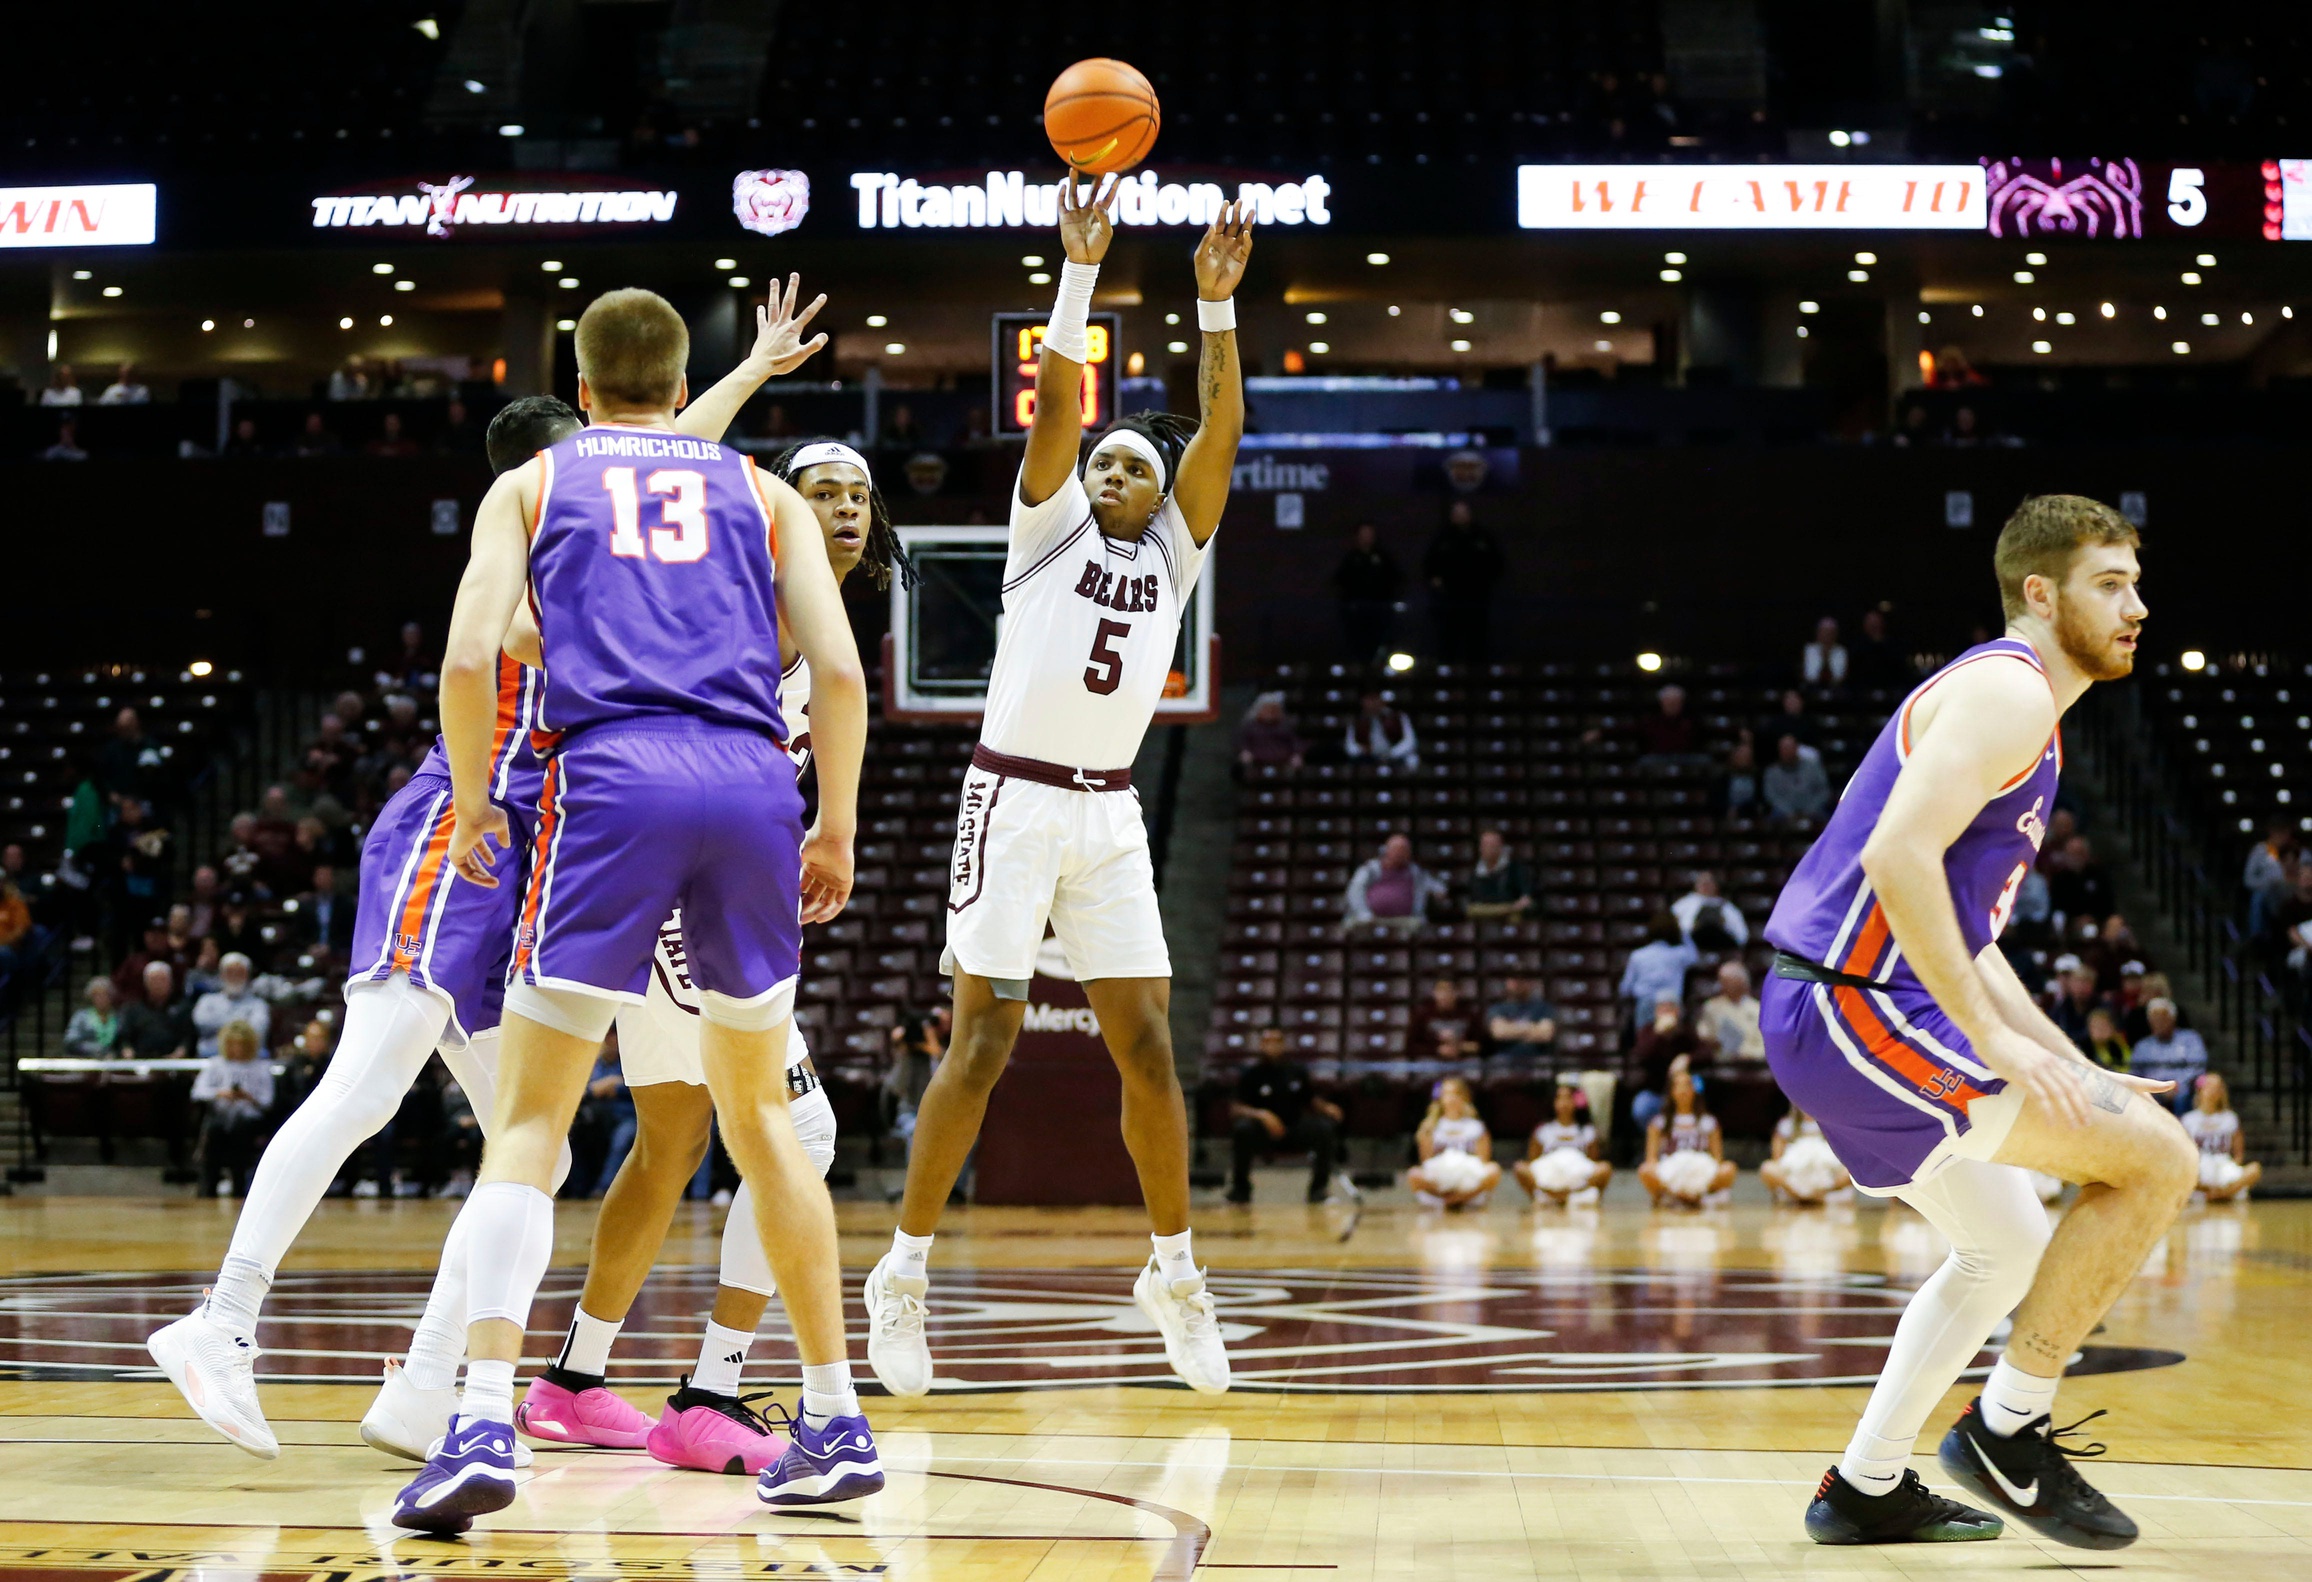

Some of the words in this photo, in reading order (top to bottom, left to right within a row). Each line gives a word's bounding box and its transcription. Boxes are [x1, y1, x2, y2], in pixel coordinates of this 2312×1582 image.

[312, 195, 431, 227] TITAN
[453, 191, 677, 224] NUTRITION
[2167, 168, 2207, 227] 5
[575, 436, 722, 461] HUMRICHOUS
[602, 466, 709, 564] 13
[1074, 559, 1158, 613] BEARS
[1083, 617, 1131, 695] 5
[395, 932, 422, 957] UE
[1022, 1003, 1102, 1037] Mercy
